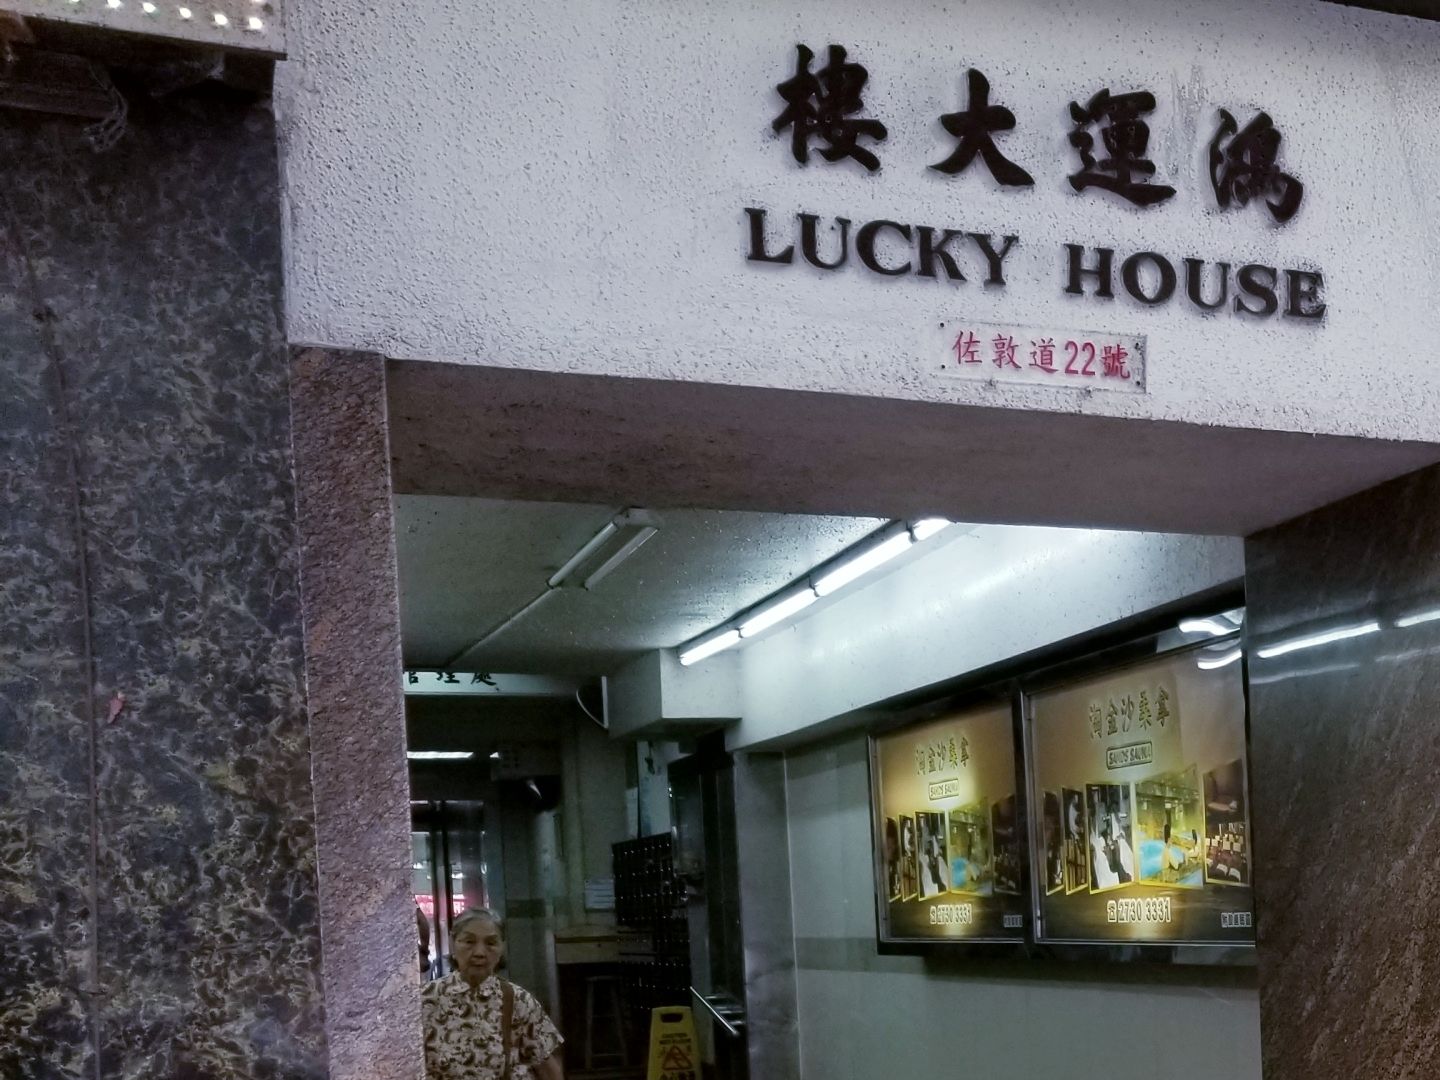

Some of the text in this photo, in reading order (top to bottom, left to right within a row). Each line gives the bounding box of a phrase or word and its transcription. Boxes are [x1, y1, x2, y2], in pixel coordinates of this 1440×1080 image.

[744, 206, 1327, 320] LUCKY HOUSE
[952, 330, 1131, 380] 佐敦道22號
[1117, 897, 1171, 923] 2730 3331
